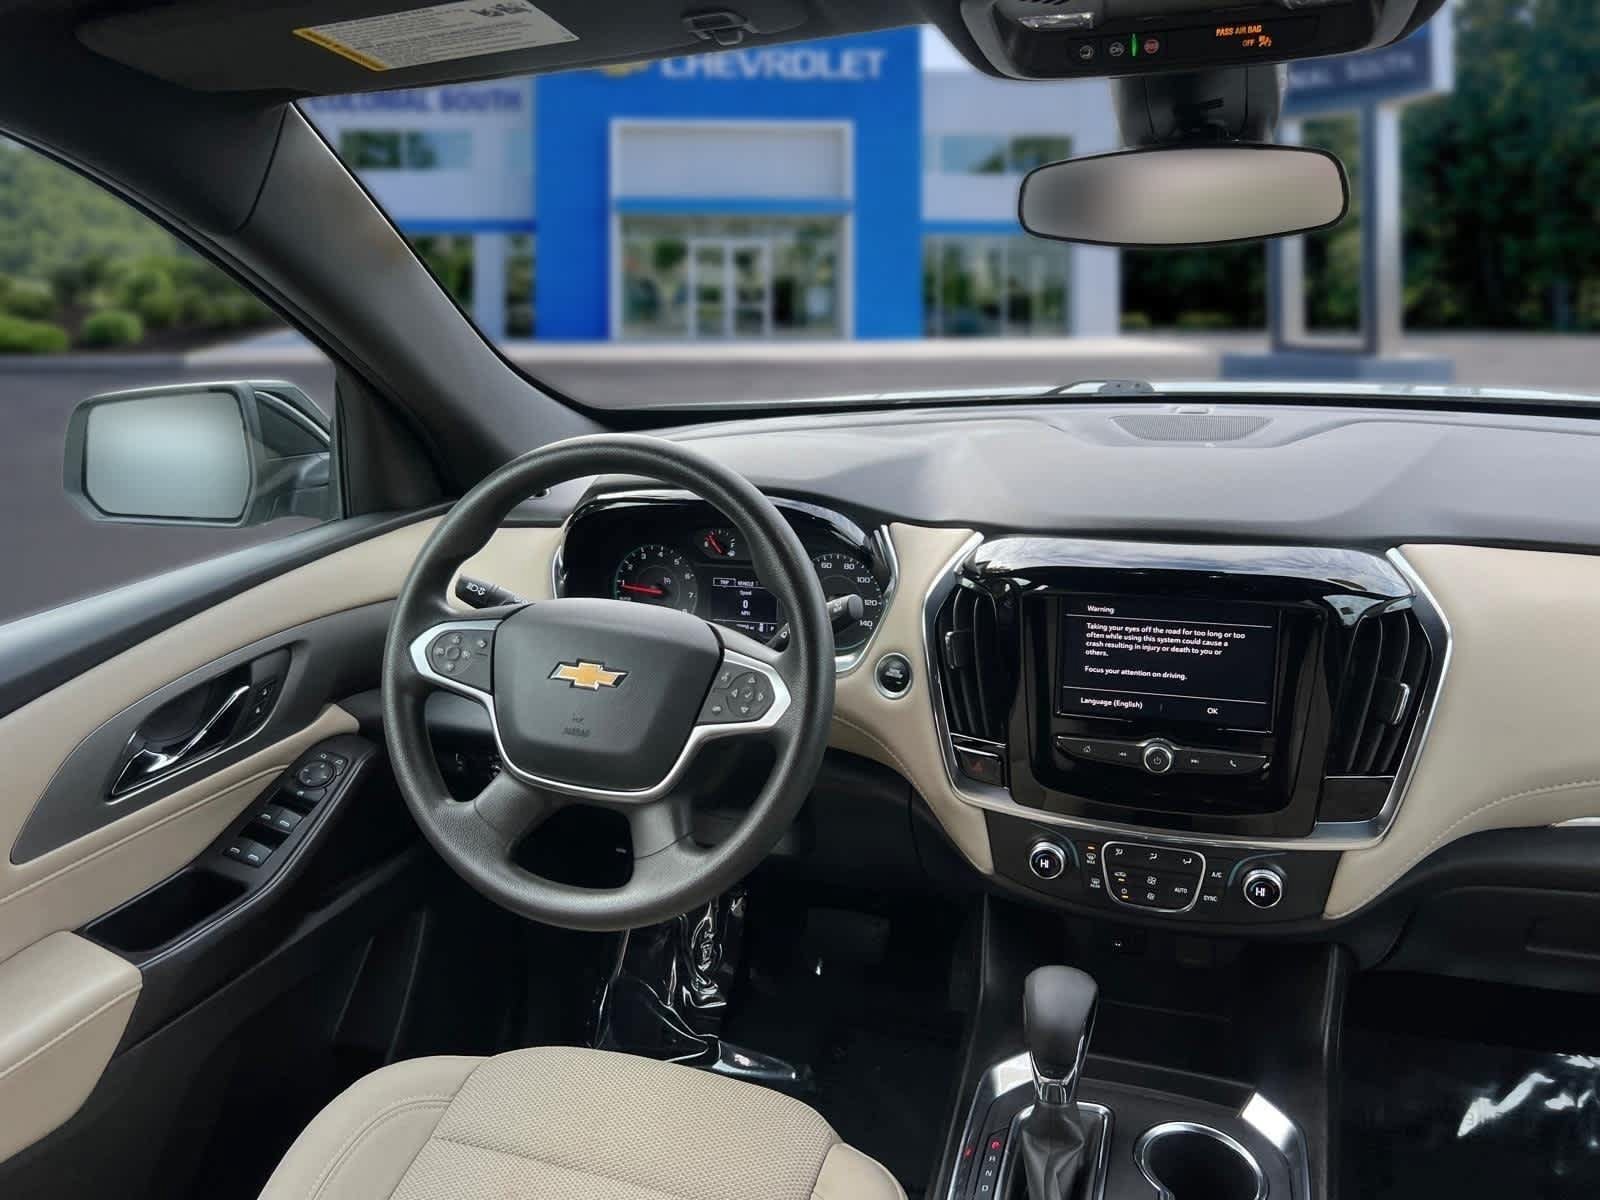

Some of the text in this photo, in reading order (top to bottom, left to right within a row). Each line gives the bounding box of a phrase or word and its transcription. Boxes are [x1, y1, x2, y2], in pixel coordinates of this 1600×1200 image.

[1216, 27, 1233, 37] PASS
[1247, 25, 1262, 34] BAG
[1242, 39, 1255, 47] OFF
[661, 49, 885, 80] CHEVROLET
[743, 600, 749, 609] 0
[1087, 605, 1115, 615] Warning
[1086, 622, 1108, 632] Taking
[1182, 628, 1193, 636] for
[1207, 629, 1223, 639] long
[1086, 631, 1105, 639] often
[1124, 635, 1142, 643] using
[1085, 649, 1109, 657] others.
[1105, 642, 1133, 651] resulting
[1142, 644, 1161, 653] injury
[1084, 665, 1104, 674] Focus
[1121, 669, 1151, 677] attention
[1162, 672, 1188, 681] driving.
[1080, 697, 1143, 710] Language (English)
[1207, 707, 1219, 715] OK
[1211, 871, 1223, 879] A/C
